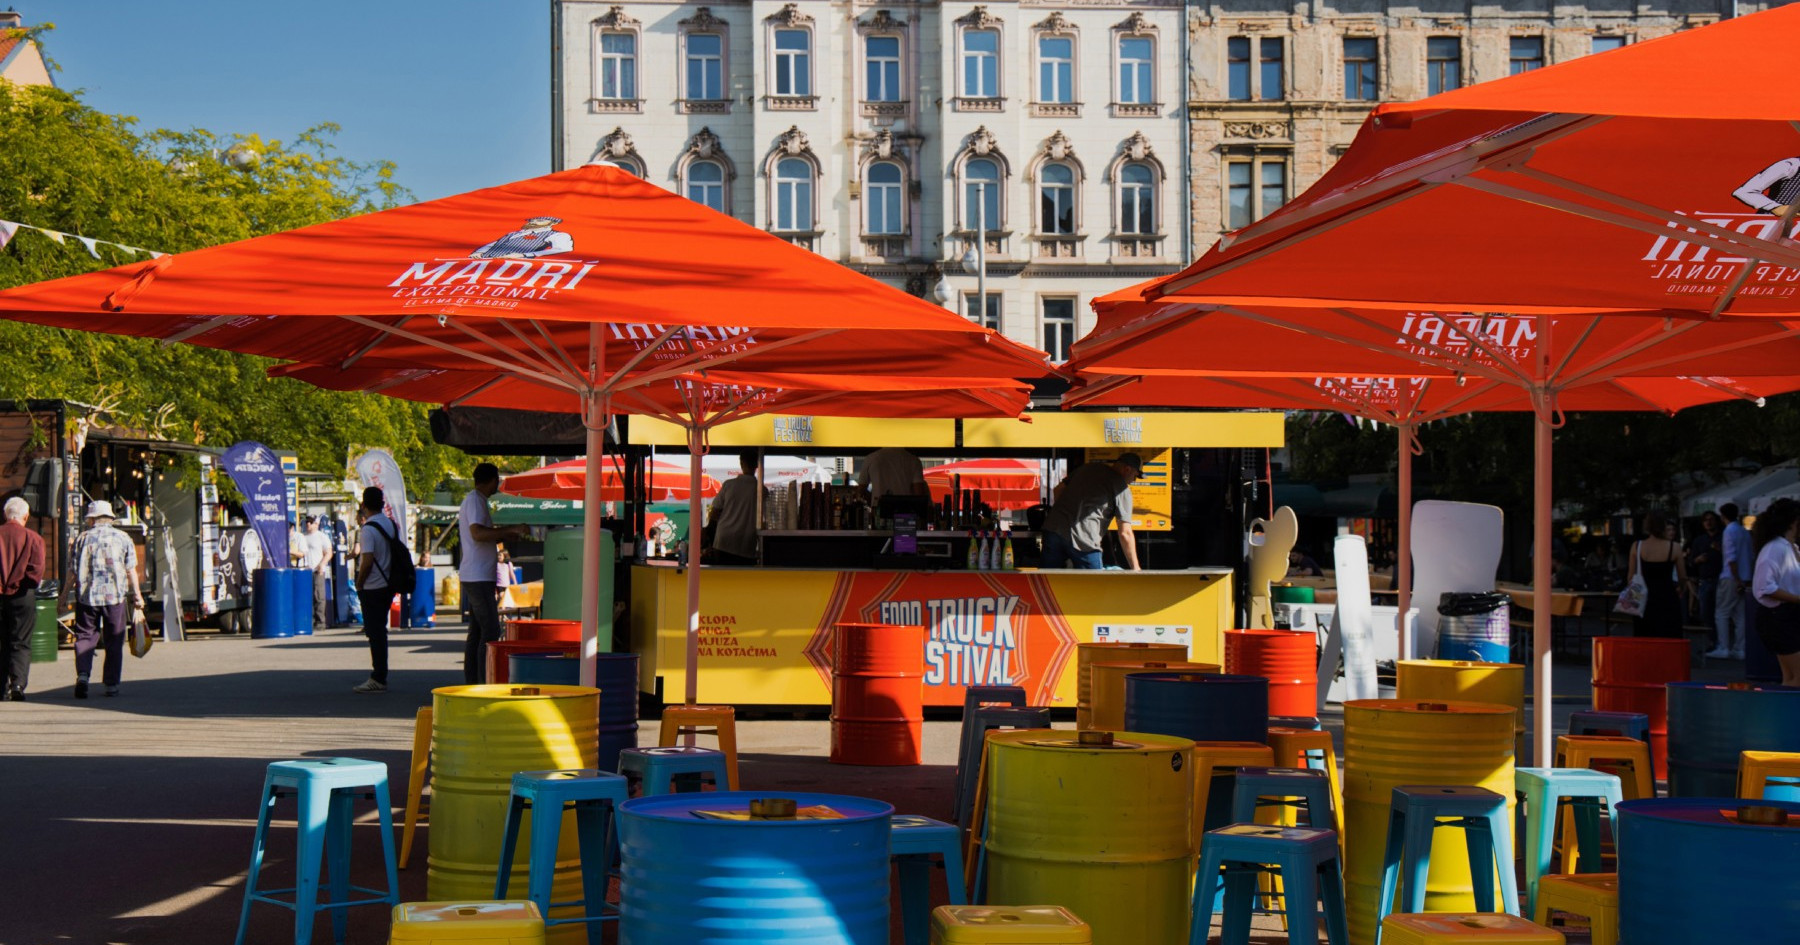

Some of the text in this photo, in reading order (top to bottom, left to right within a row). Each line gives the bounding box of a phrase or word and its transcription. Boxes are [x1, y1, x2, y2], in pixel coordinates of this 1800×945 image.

[387, 259, 599, 290] MADRÍ
[393, 285, 553, 300] EXCEPCIONAL
[422, 298, 453, 306] ALMA
[473, 299, 519, 308] MADRID
[788, 416, 813, 430] TRUCK
[1118, 416, 1143, 431] TRUCK
[774, 427, 813, 442] FESTIVAL
[1104, 428, 1142, 443] FESTIVAL
[698, 615, 737, 625] KLOPA
[927, 596, 1020, 649] TRUCK
[698, 626, 731, 635] CUGA
[697, 637, 738, 646] MJUZA
[697, 646, 777, 657] NA KOTAČIMA
[923, 640, 1014, 686] STIVAL
